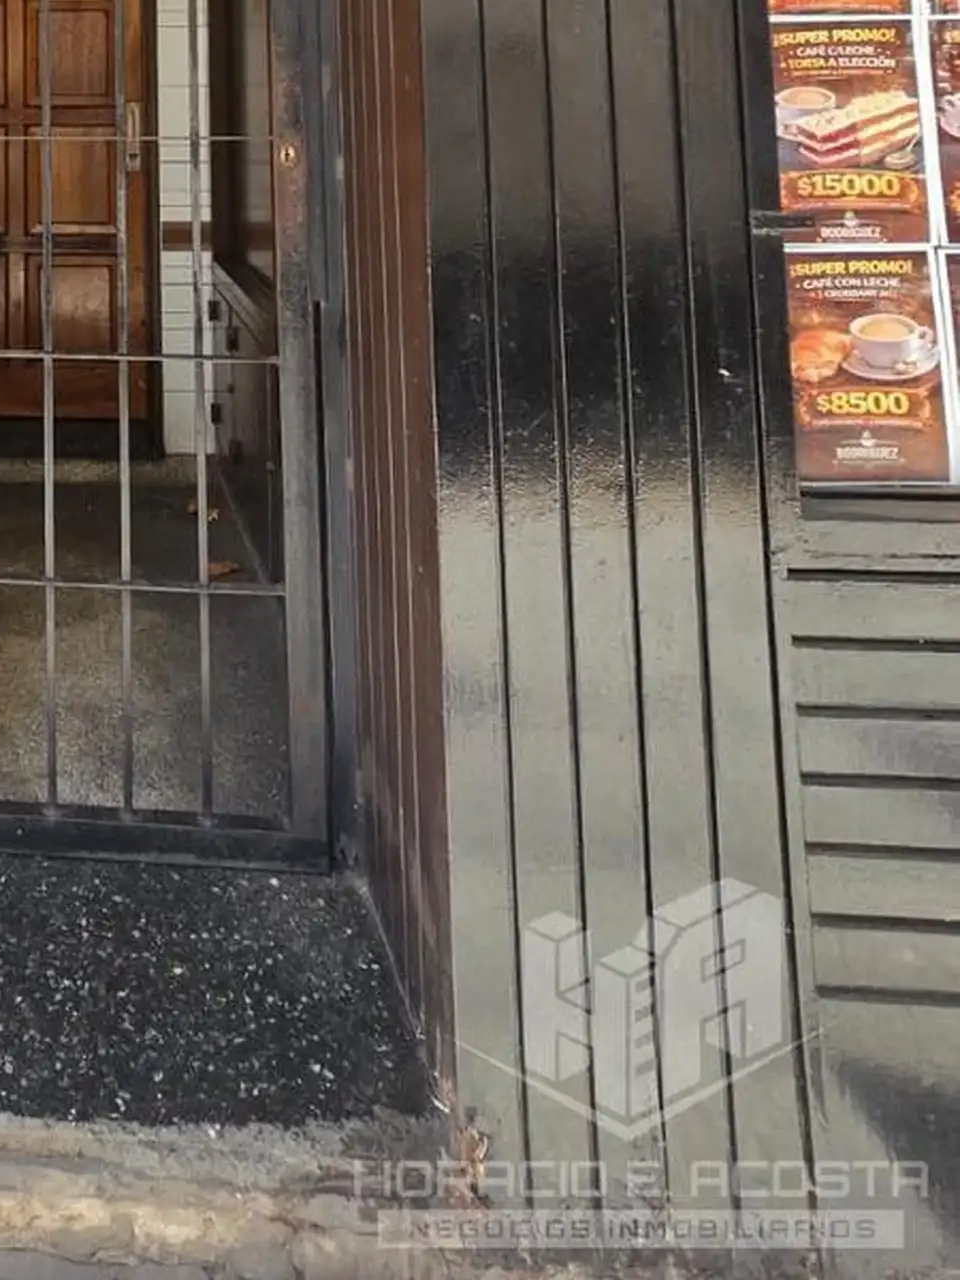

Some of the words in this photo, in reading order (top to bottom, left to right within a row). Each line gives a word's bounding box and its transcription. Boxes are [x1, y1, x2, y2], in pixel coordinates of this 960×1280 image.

[832, 28, 896, 42] PROMO!
[798, 175, 901, 196] $15000
[848, 260, 913, 274] PROMO!
[816, 392, 910, 414] $8500
